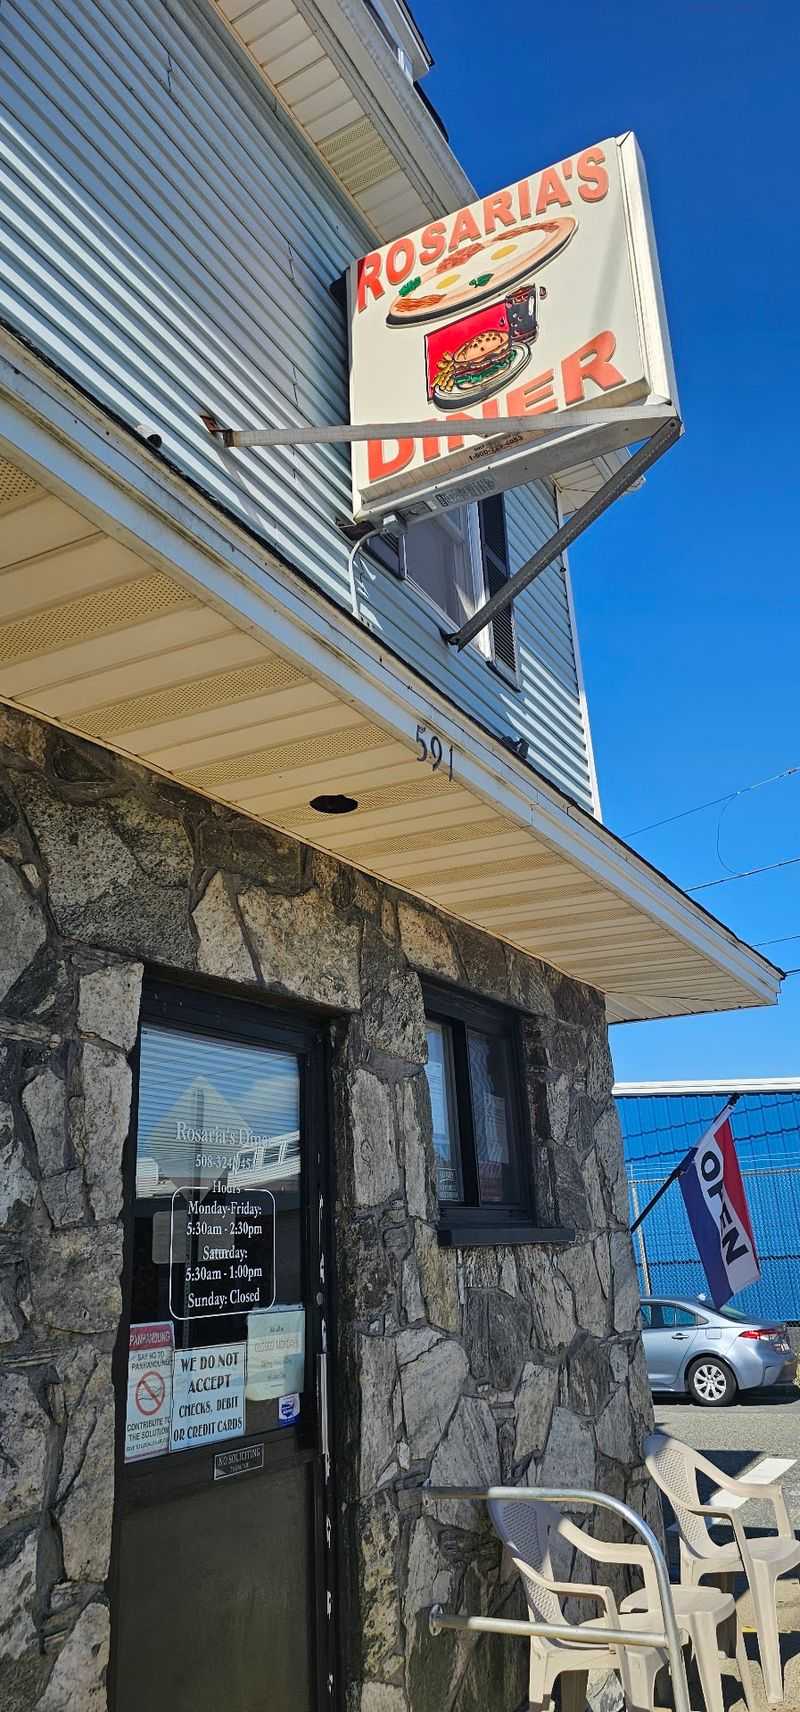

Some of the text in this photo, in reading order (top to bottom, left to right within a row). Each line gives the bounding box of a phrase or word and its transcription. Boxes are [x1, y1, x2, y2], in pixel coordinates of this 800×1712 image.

[358, 146, 609, 314] ROSARIA'S
[367, 331, 627, 484] DINER
[416, 725, 454, 782] 591
[176, 1121, 273, 1147] Rosaria's Diner
[212, 1180, 241, 1194] Hours
[187, 1200, 262, 1218] Monday-Friday:
[701, 1150, 749, 1265] OPEN
[186, 1221, 222, 1236] 5:30am
[229, 1222, 262, 1238] 2:30pm
[202, 1245, 248, 1262] Saturday:
[185, 1266, 222, 1282] 5:30am
[229, 1264, 263, 1281] 1:00pm
[187, 1288, 260, 1309] Sunday: Closed
[180, 1352, 239, 1373] WE DO NOT
[187, 1374, 232, 1394] ACCEPT
[216, 1396, 239, 1411] DEBIT
[127, 1417, 164, 1431] CONTRIBUTE
[128, 1427, 169, 1440] THE SOLUTION
[173, 1417, 243, 1442] OR CREDIT CARDS
[217, 1455, 227, 1465] NO
